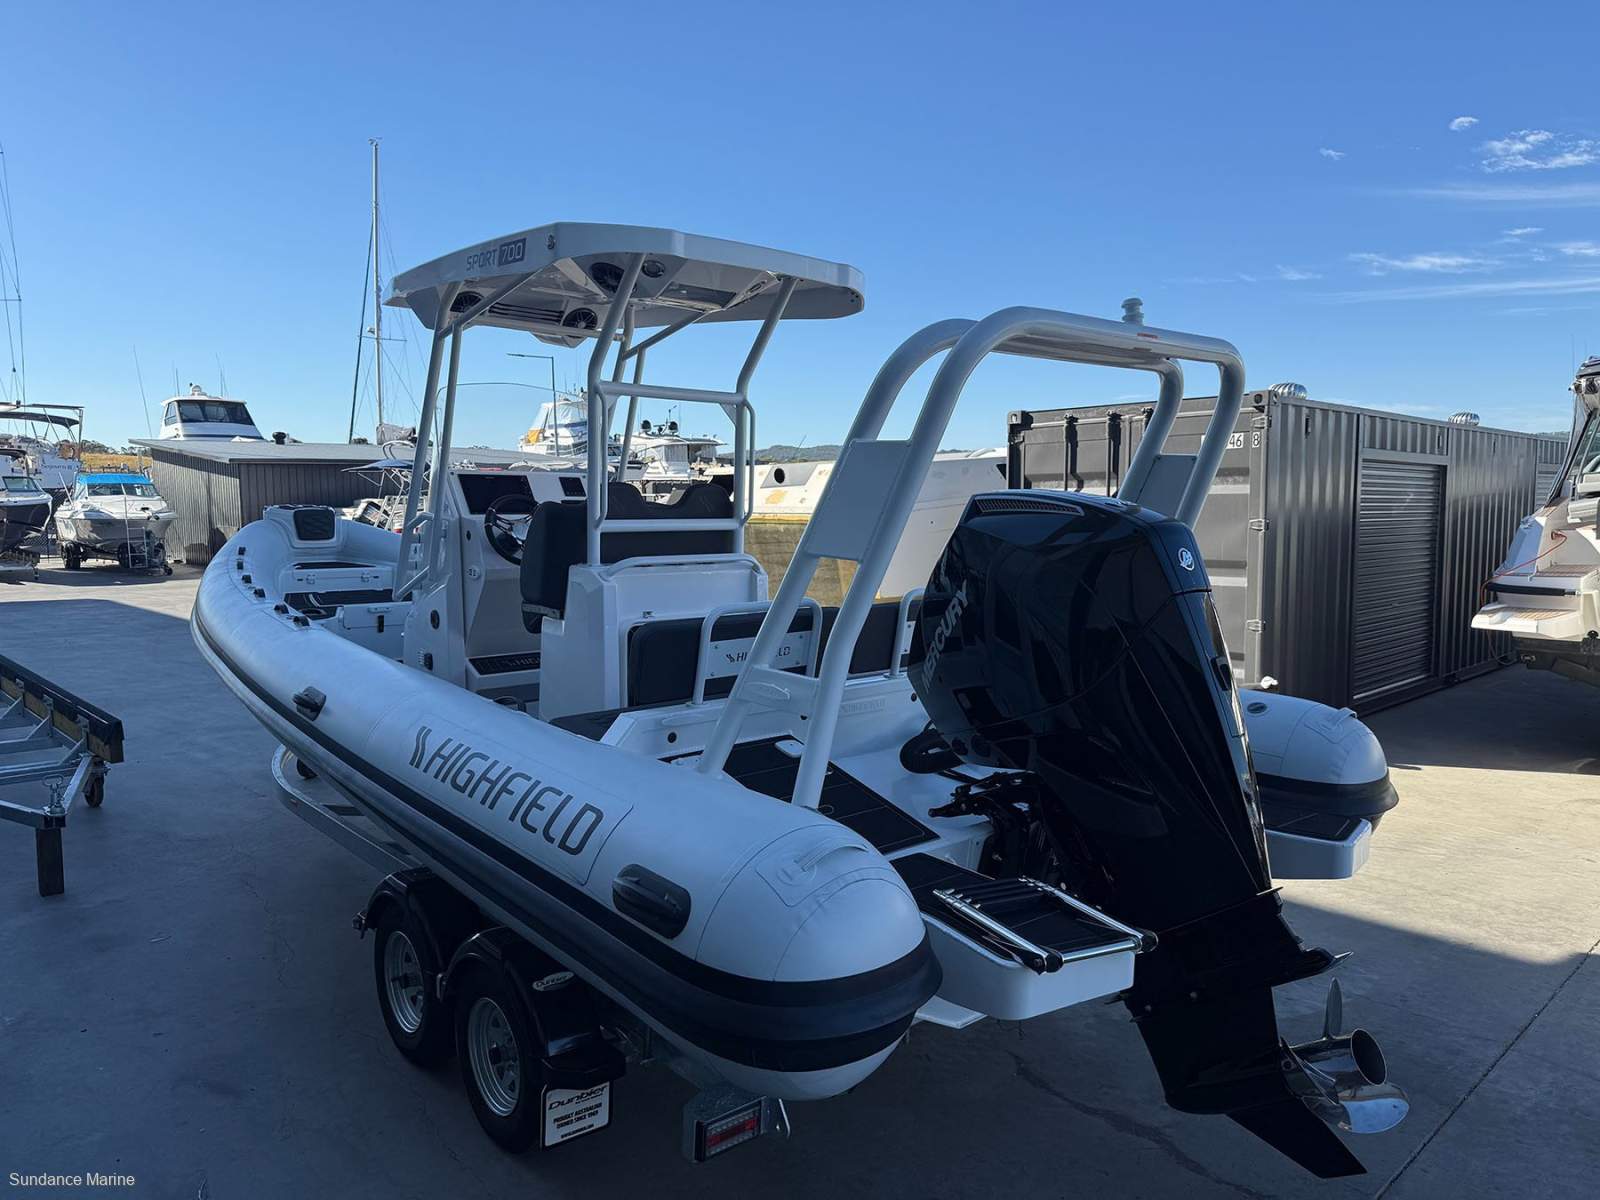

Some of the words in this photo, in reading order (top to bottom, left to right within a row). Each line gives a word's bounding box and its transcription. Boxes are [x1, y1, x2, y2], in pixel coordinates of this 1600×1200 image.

[466, 249, 497, 271] SPORT
[501, 241, 524, 264] 700
[1253, 433, 1260, 447] 8
[921, 578, 968, 694] MERCURY
[423, 738, 604, 856] HIGHFIELD
[549, 1085, 608, 1110] Dunbier
